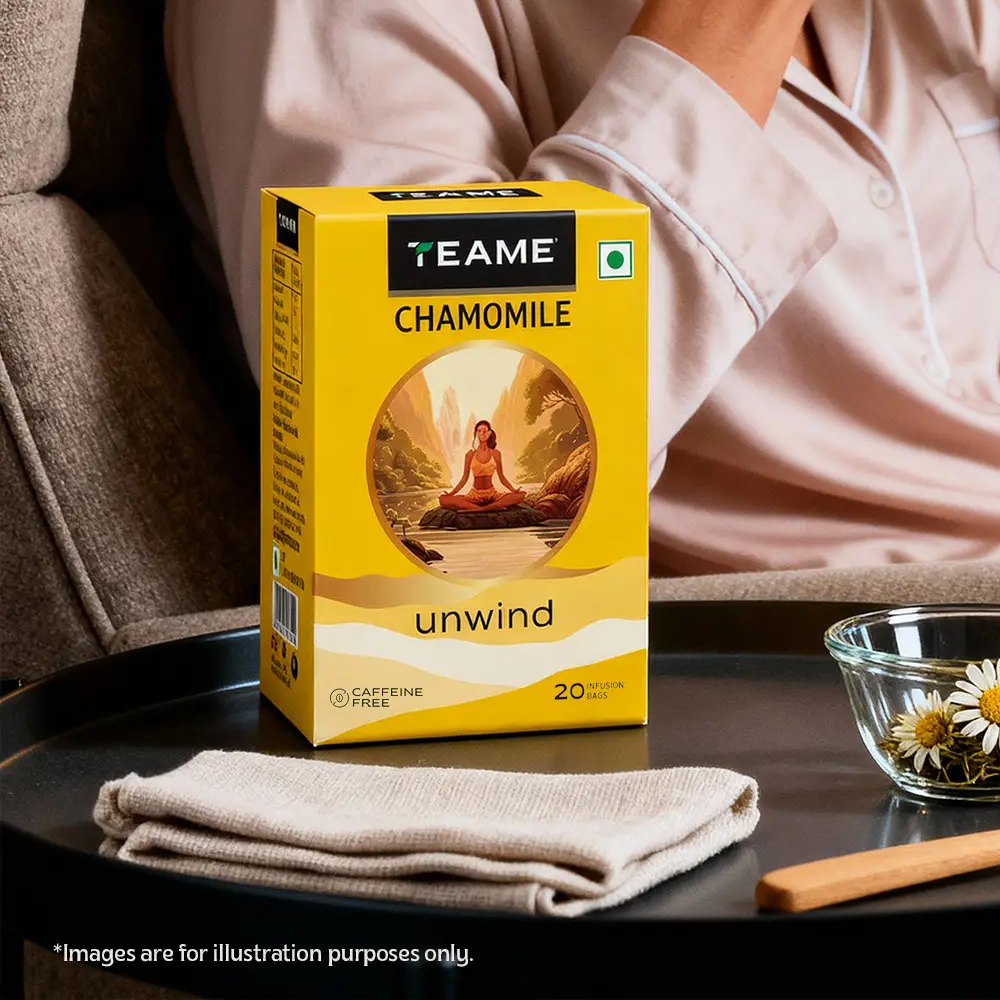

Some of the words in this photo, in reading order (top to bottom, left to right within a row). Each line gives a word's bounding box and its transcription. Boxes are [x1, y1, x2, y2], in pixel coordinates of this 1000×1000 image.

[407, 238, 555, 268] TEAME
[394, 300, 572, 333] CHAMOMILE
[415, 599, 554, 634] unwind
[351, 687, 424, 697] CAFFEINE
[554, 682, 585, 701] 20
[586, 681, 624, 690] INFUSION
[586, 691, 608, 700] BAGS
[352, 698, 390, 708] FREE
